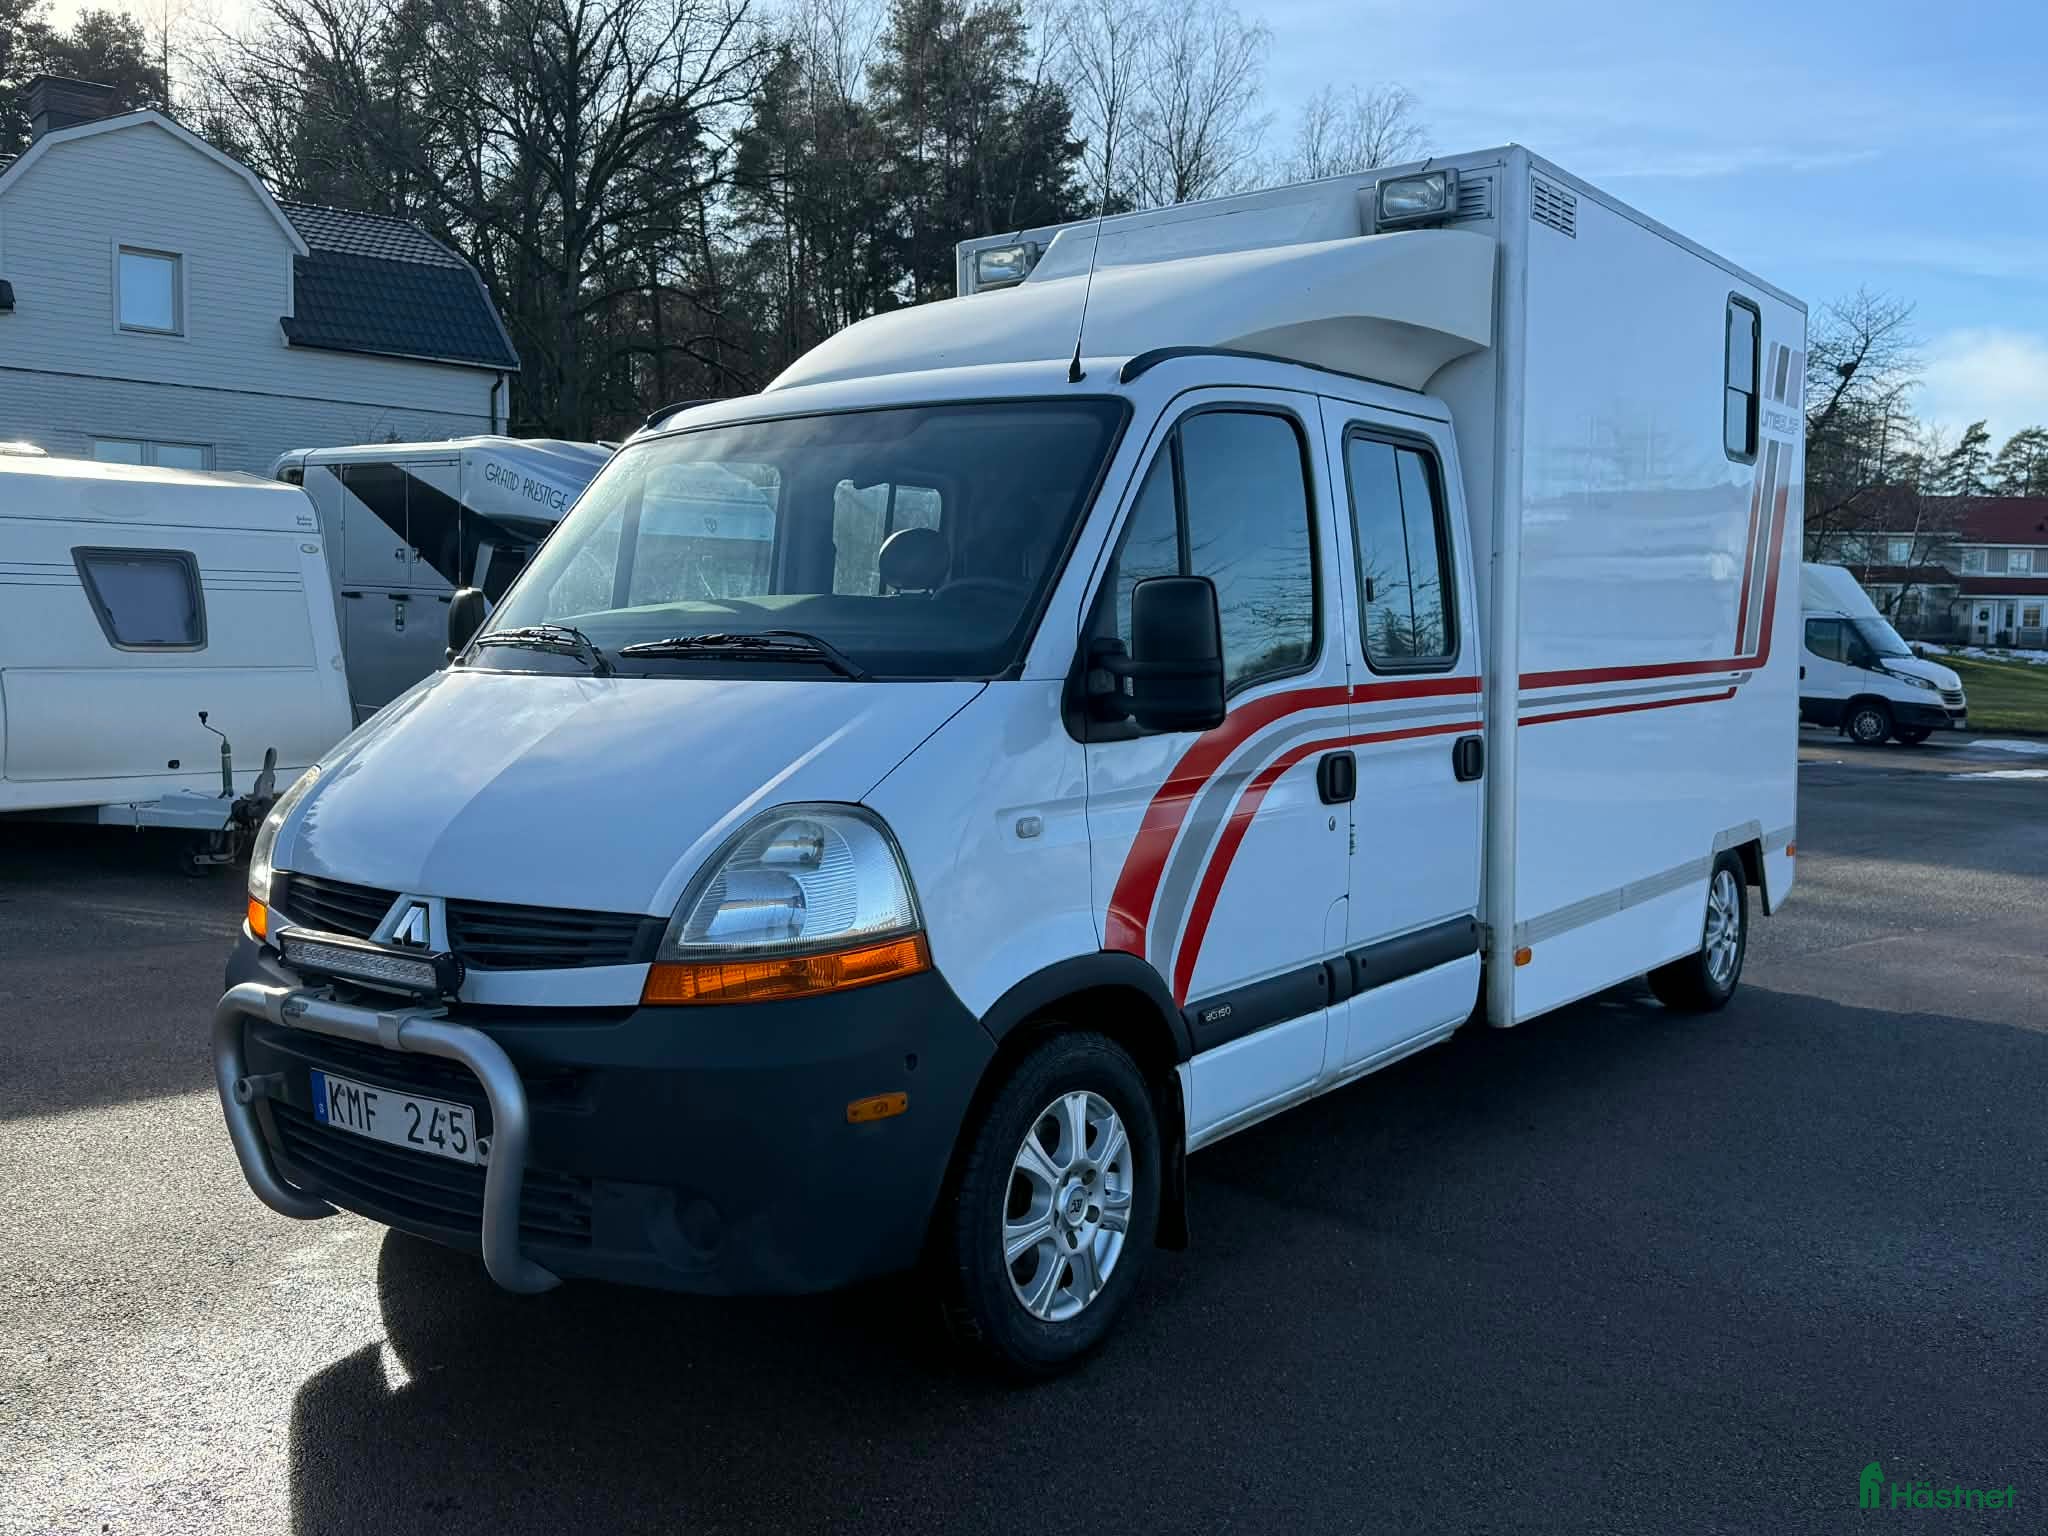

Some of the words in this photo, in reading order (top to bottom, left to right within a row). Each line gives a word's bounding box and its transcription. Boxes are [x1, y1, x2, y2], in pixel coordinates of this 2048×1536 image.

[485, 463, 519, 491] GRAND
[523, 478, 568, 512] PRESTIGE
[328, 1081, 378, 1132] KMF
[404, 1102, 467, 1154] 245
